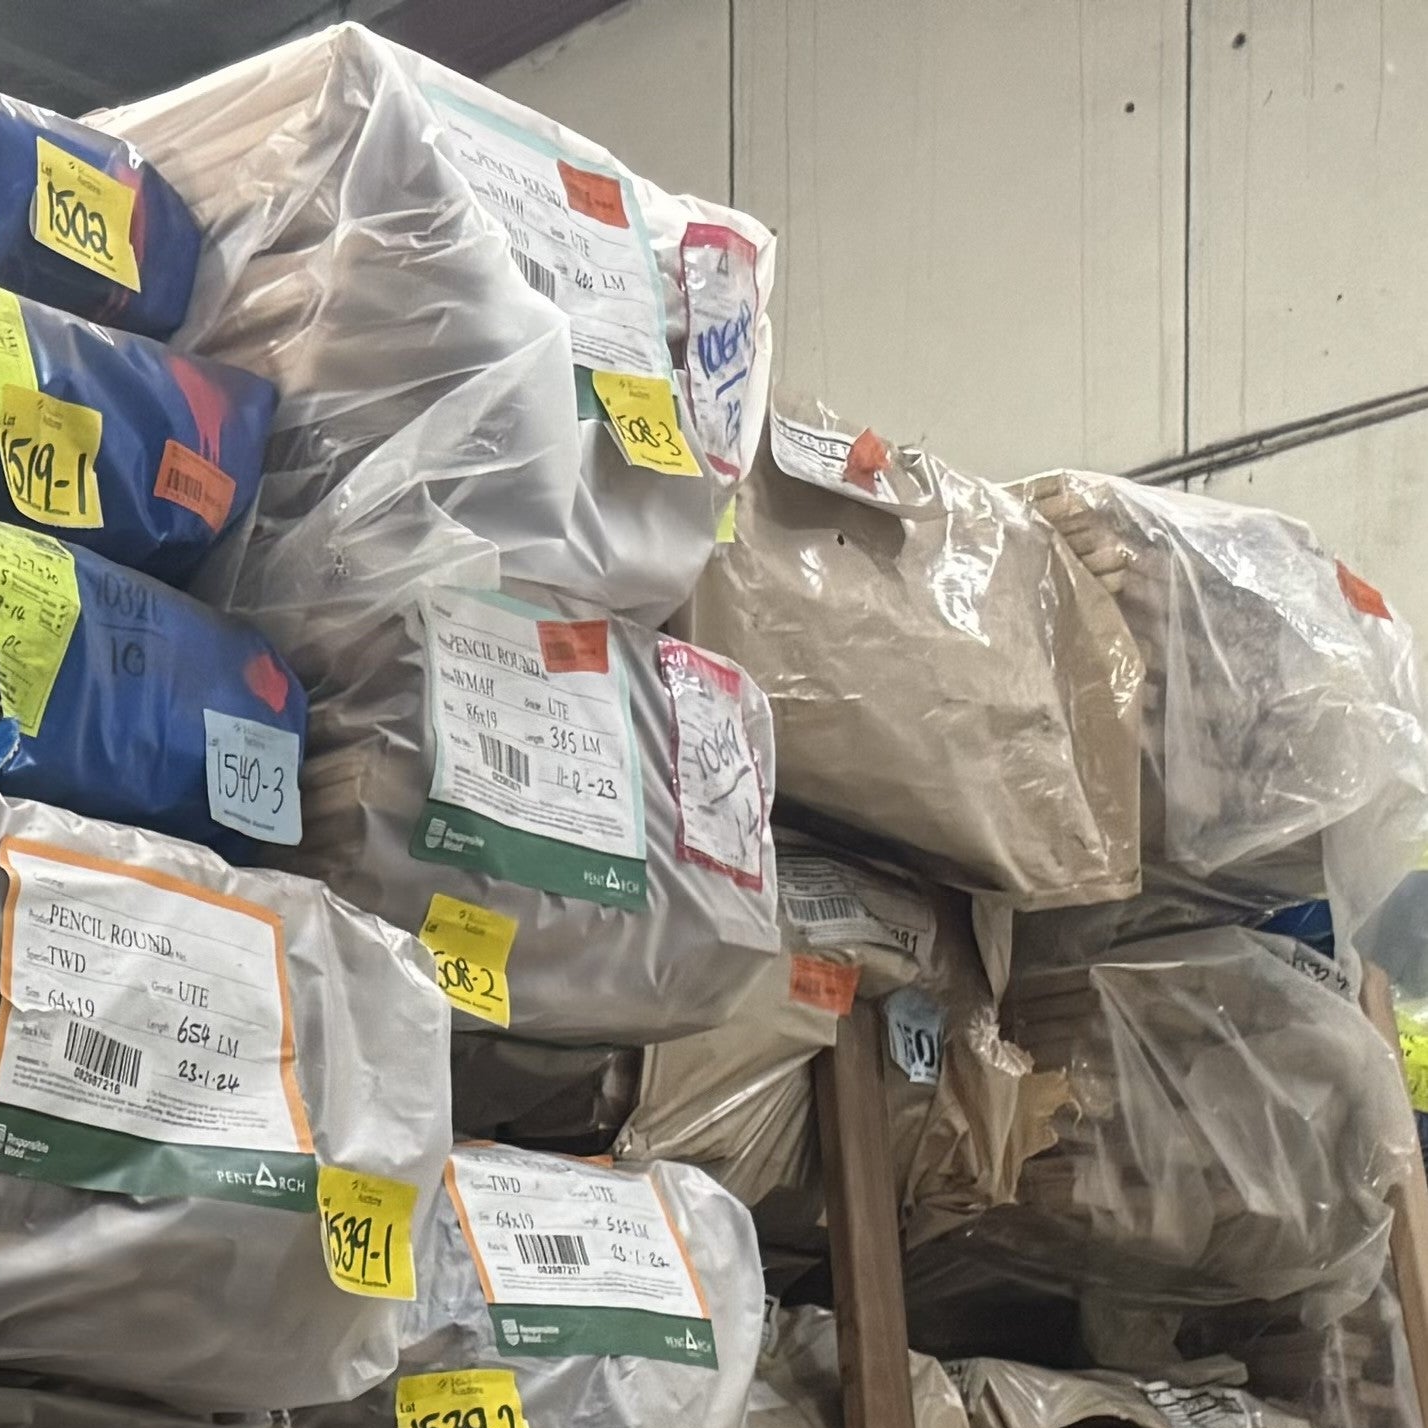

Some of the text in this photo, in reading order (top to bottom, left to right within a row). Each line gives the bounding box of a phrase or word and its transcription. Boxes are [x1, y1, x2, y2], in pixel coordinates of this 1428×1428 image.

[46, 180, 114, 262] 1502
[448, 632, 495, 663] PENCIL
[216, 750, 285, 814] 1540-3
[49, 904, 172, 956] PENCIL ROUND
[47, 946, 209, 1009] TWD UTE
[47, 989, 96, 1018] 64x19
[176, 1016, 210, 1046] 654
[491, 1175, 522, 1194] TWD
[325, 1211, 393, 1285] 1539-1
